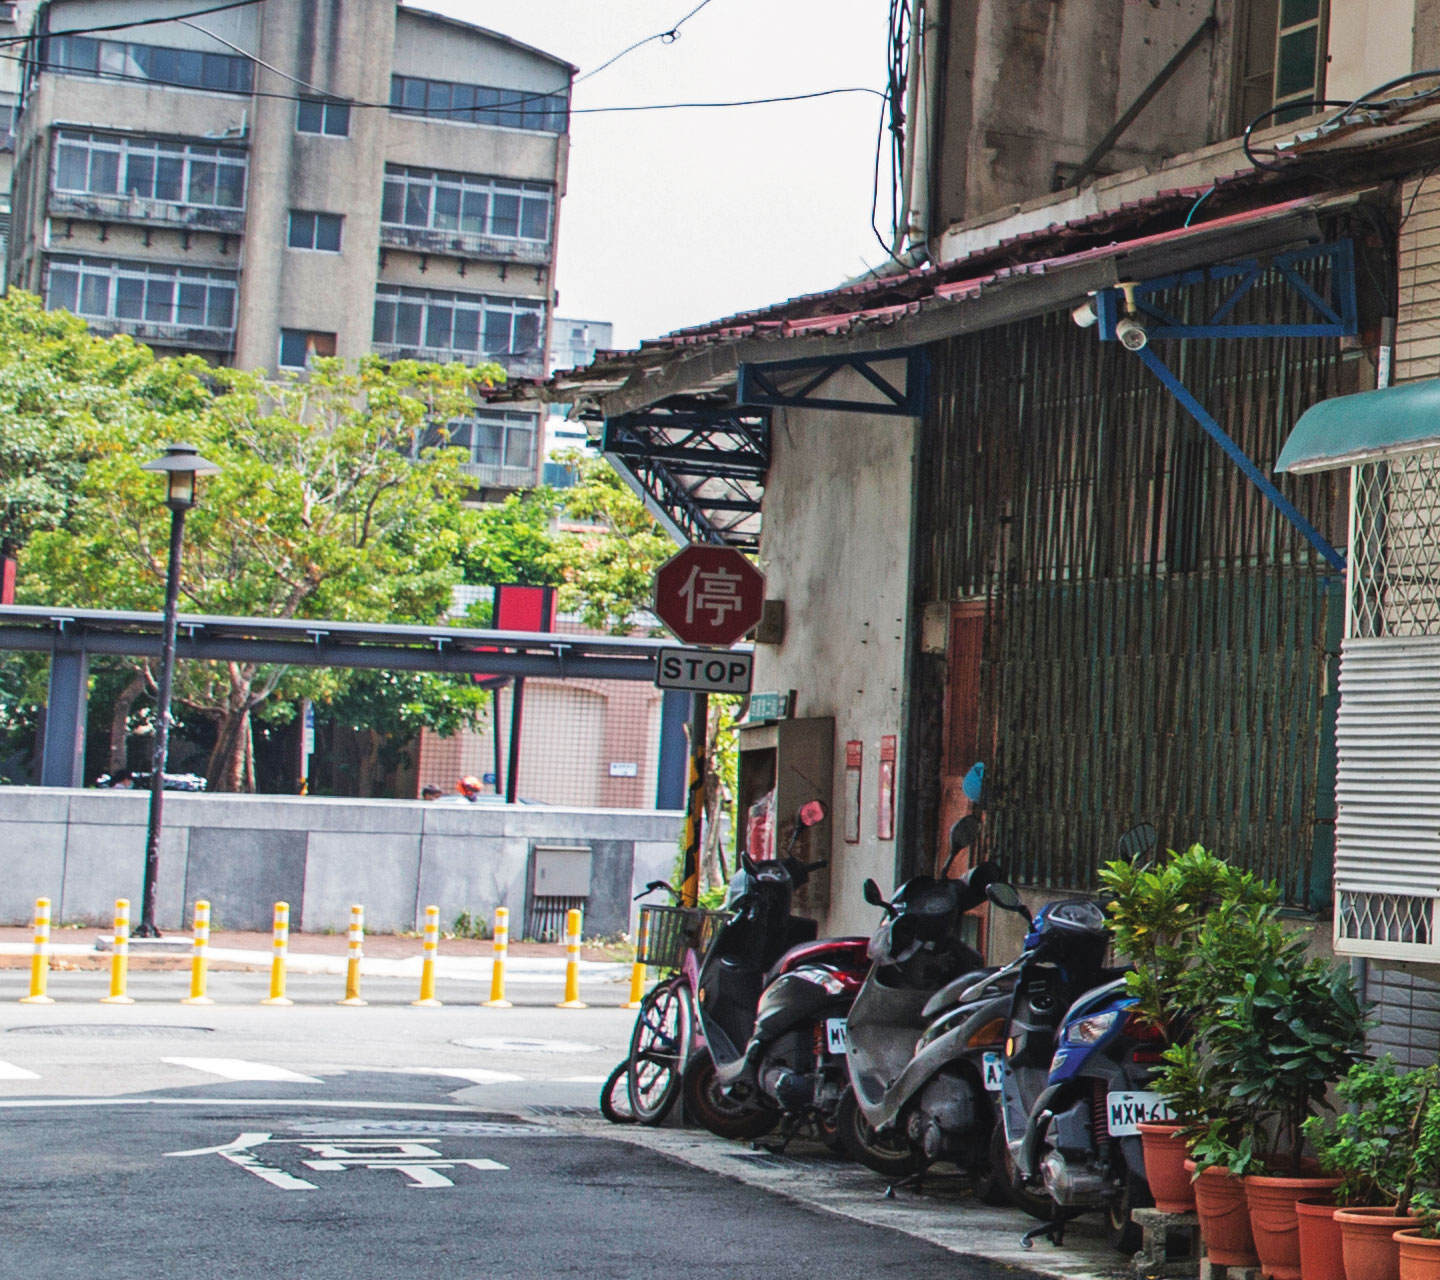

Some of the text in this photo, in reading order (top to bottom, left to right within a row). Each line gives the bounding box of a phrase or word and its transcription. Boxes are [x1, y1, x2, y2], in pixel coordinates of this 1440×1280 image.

[678, 565, 743, 626] 停
[663, 657, 747, 684] STOP
[163, 1133, 509, 1189] 停
